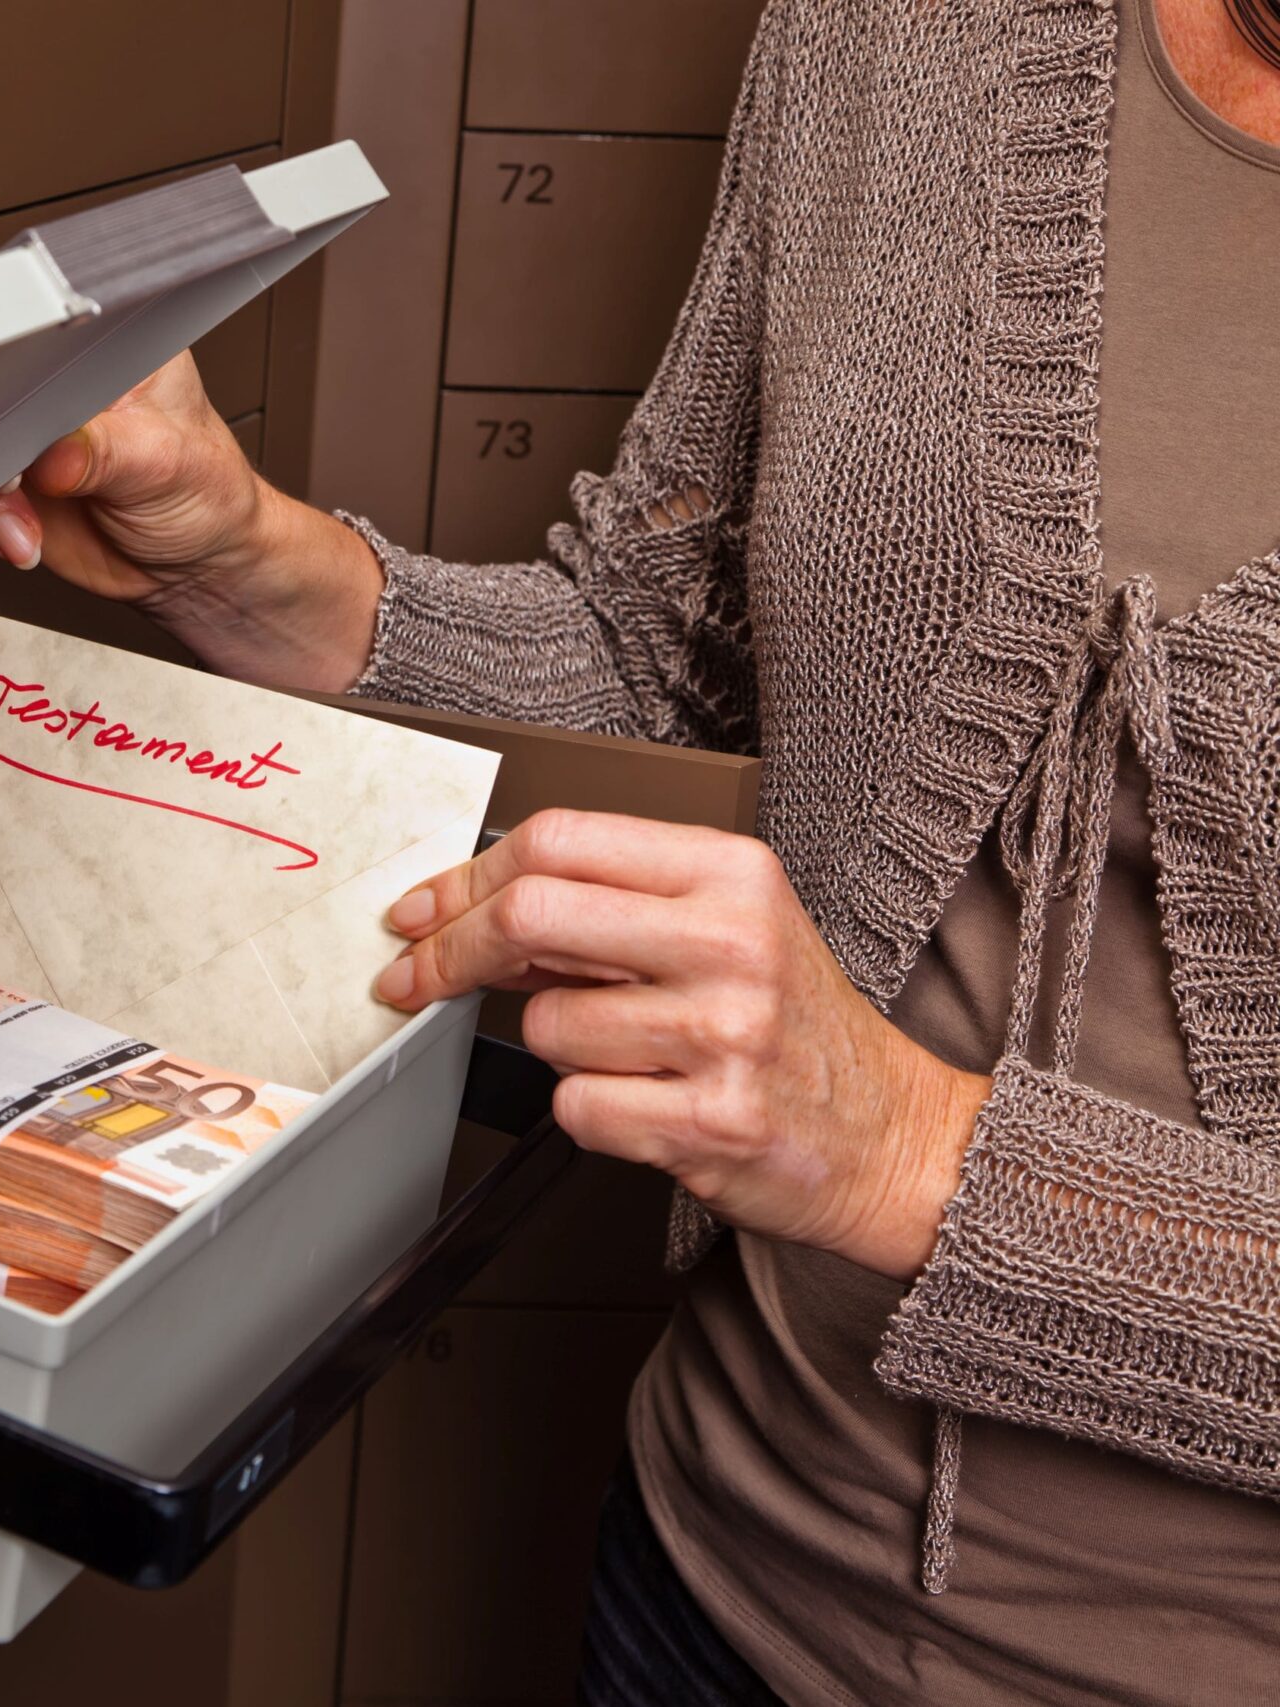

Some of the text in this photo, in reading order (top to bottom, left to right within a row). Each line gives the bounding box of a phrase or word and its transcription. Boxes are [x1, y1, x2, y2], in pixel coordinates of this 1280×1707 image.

[497, 163, 554, 204] 72
[477, 420, 533, 460] 73
[112, 1060, 256, 1121] 50
